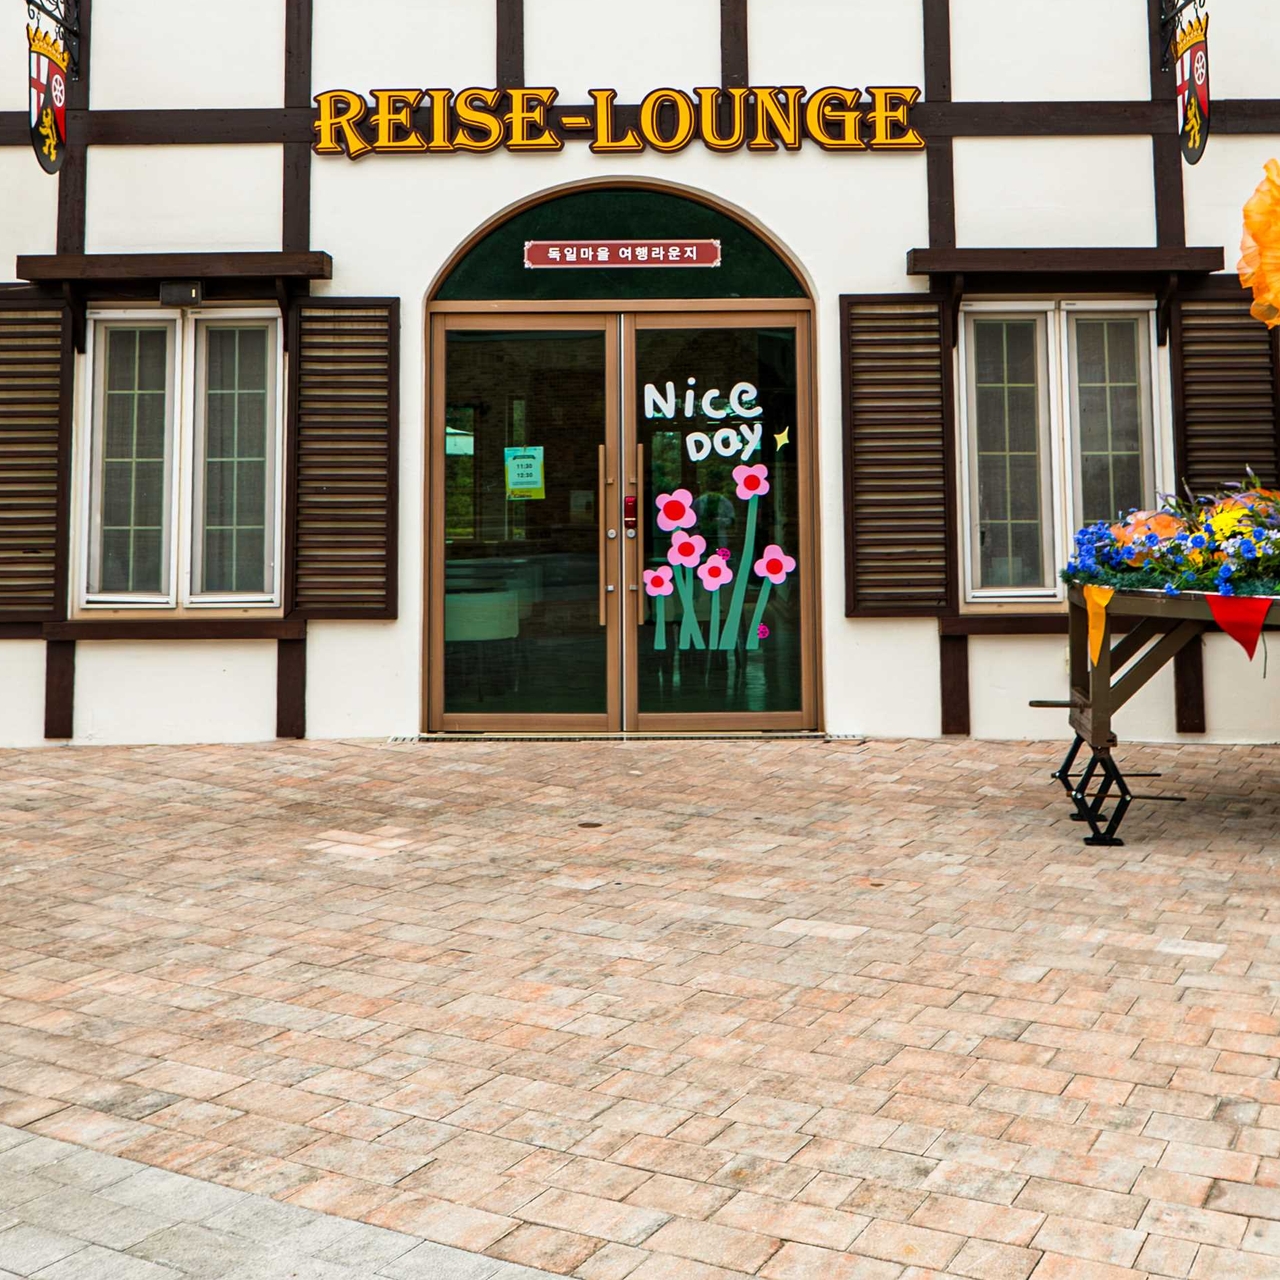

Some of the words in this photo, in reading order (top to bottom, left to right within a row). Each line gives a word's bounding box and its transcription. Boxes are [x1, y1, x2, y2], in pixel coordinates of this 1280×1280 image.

[313, 86, 927, 159] REISE-LOUNGE
[547, 246, 610, 262] 독일마을
[618, 245, 697, 262] 여행라운지
[644, 377, 763, 419] Nice
